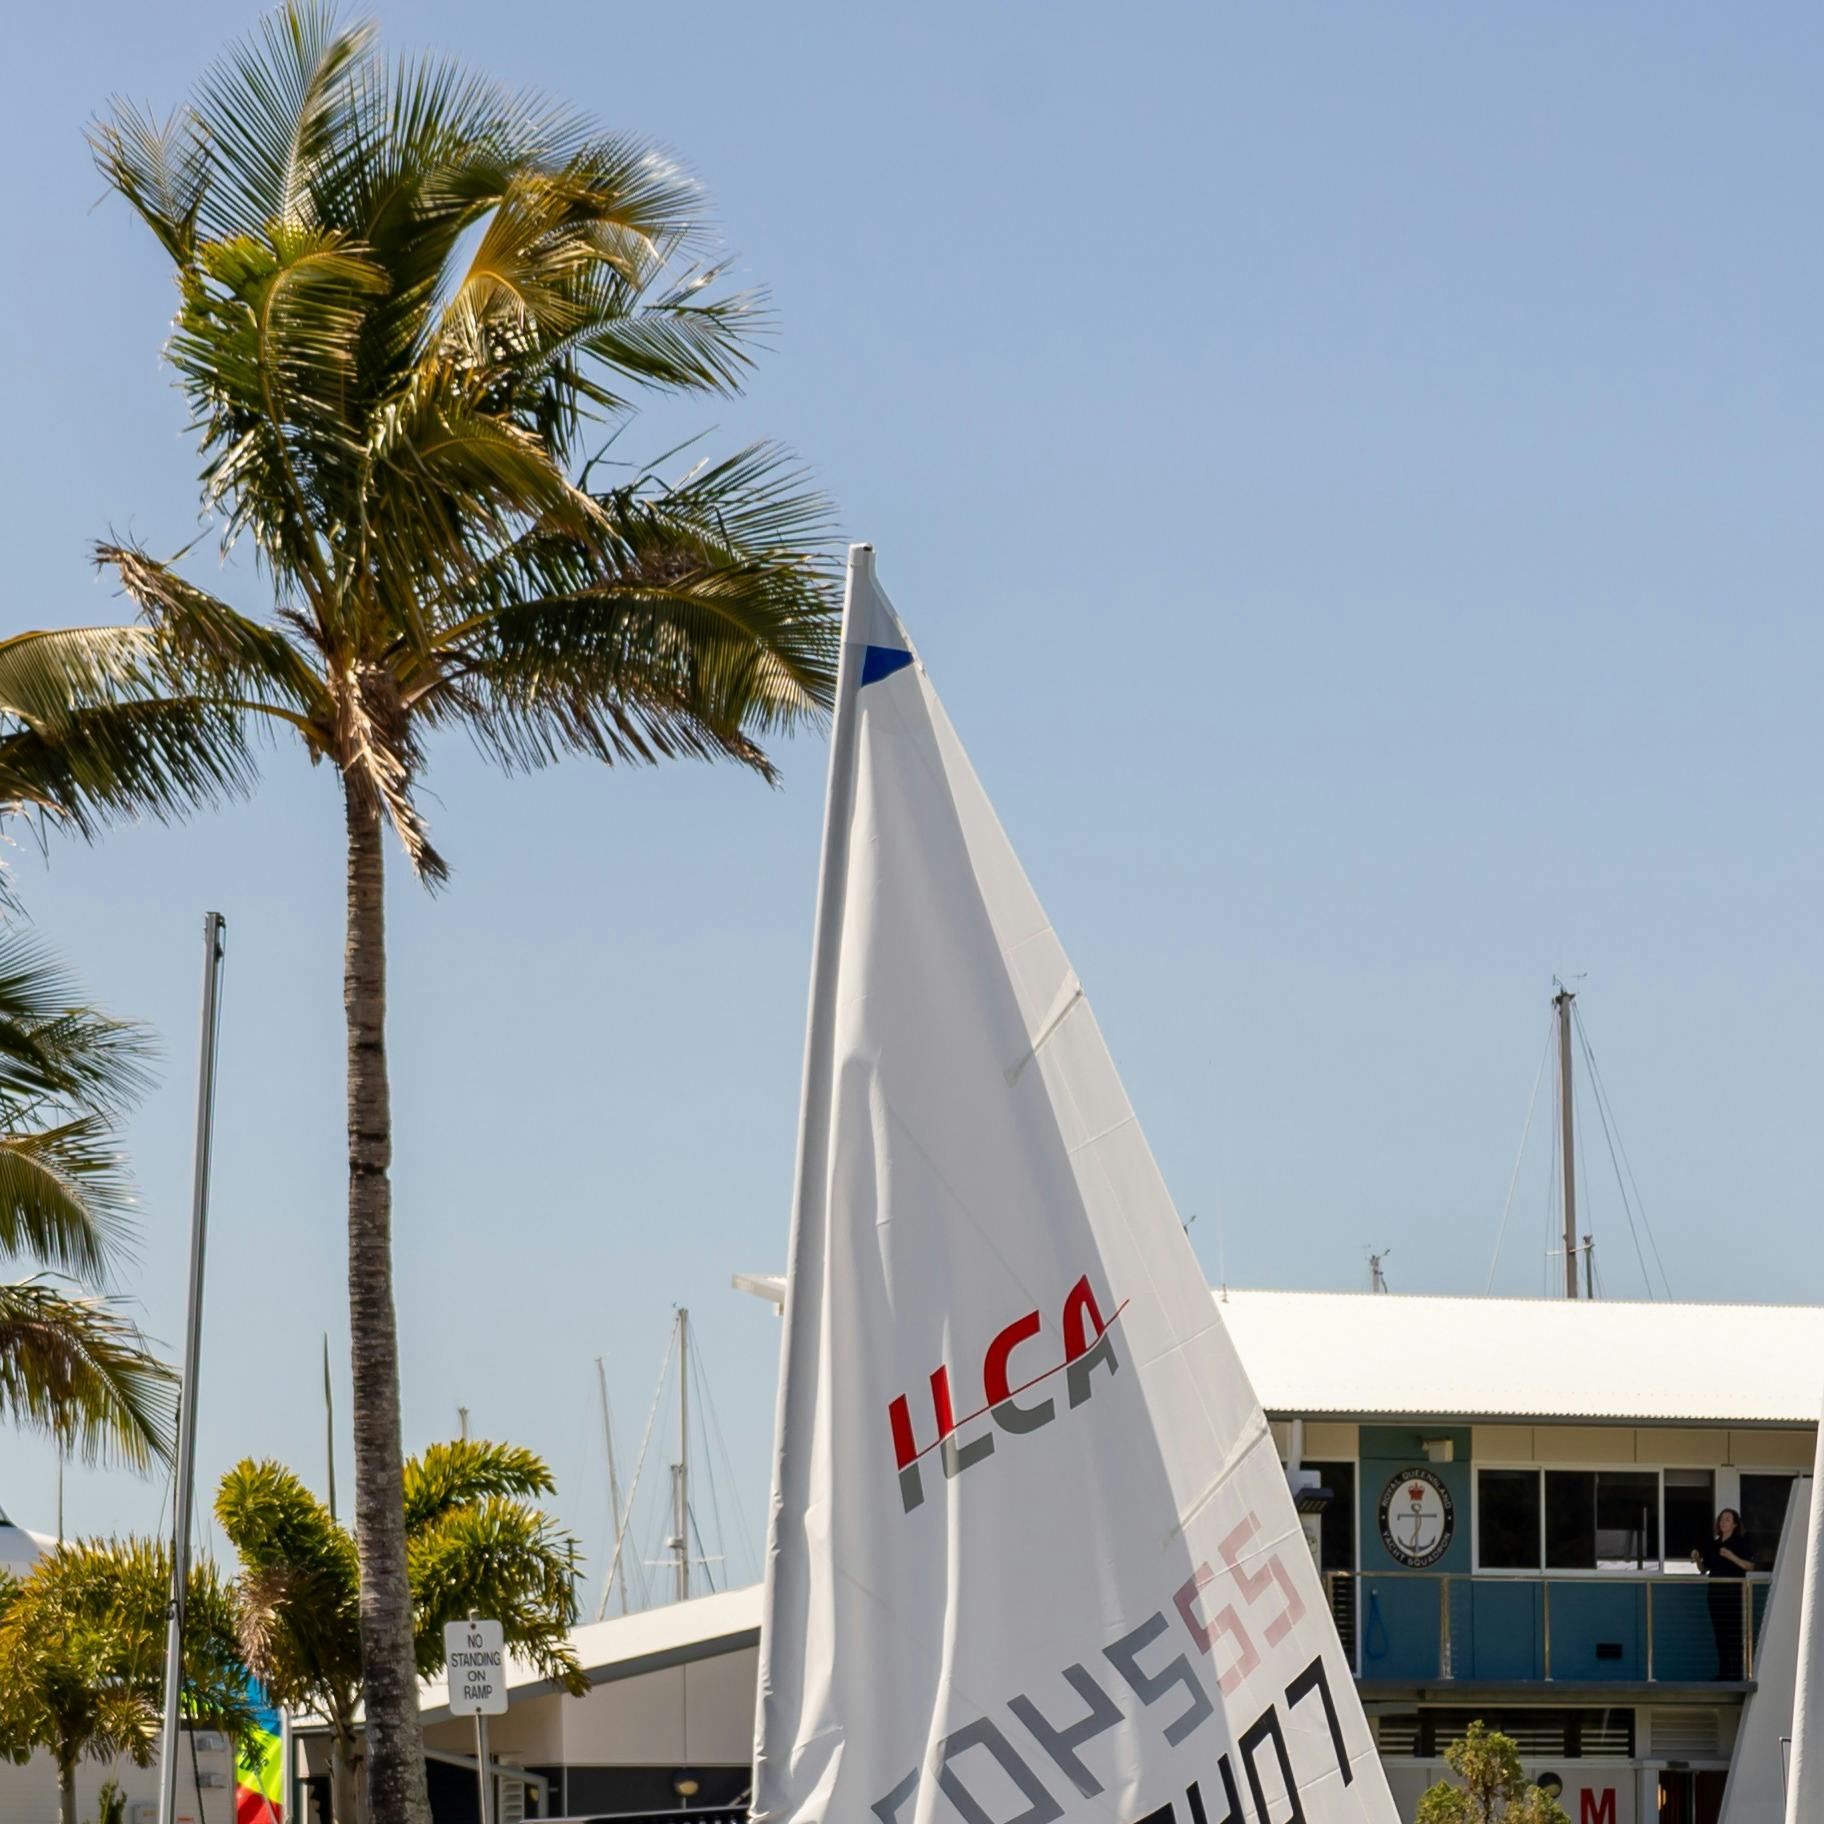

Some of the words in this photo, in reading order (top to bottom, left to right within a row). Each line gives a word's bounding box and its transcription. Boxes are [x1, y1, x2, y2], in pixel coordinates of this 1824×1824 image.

[889, 1274, 1122, 1513] ILCA
[1381, 1479, 1402, 1507] ROYAL
[1402, 1470, 1452, 1510] QUEENSLAND
[1383, 1530, 1406, 1561] YACHT
[1407, 1532, 1451, 1567] SQUADRON
[467, 1634, 483, 1648] NO
[451, 1651, 501, 1668] STANDING
[467, 1671, 486, 1681] ON
[464, 1684, 493, 1699] RAMP
